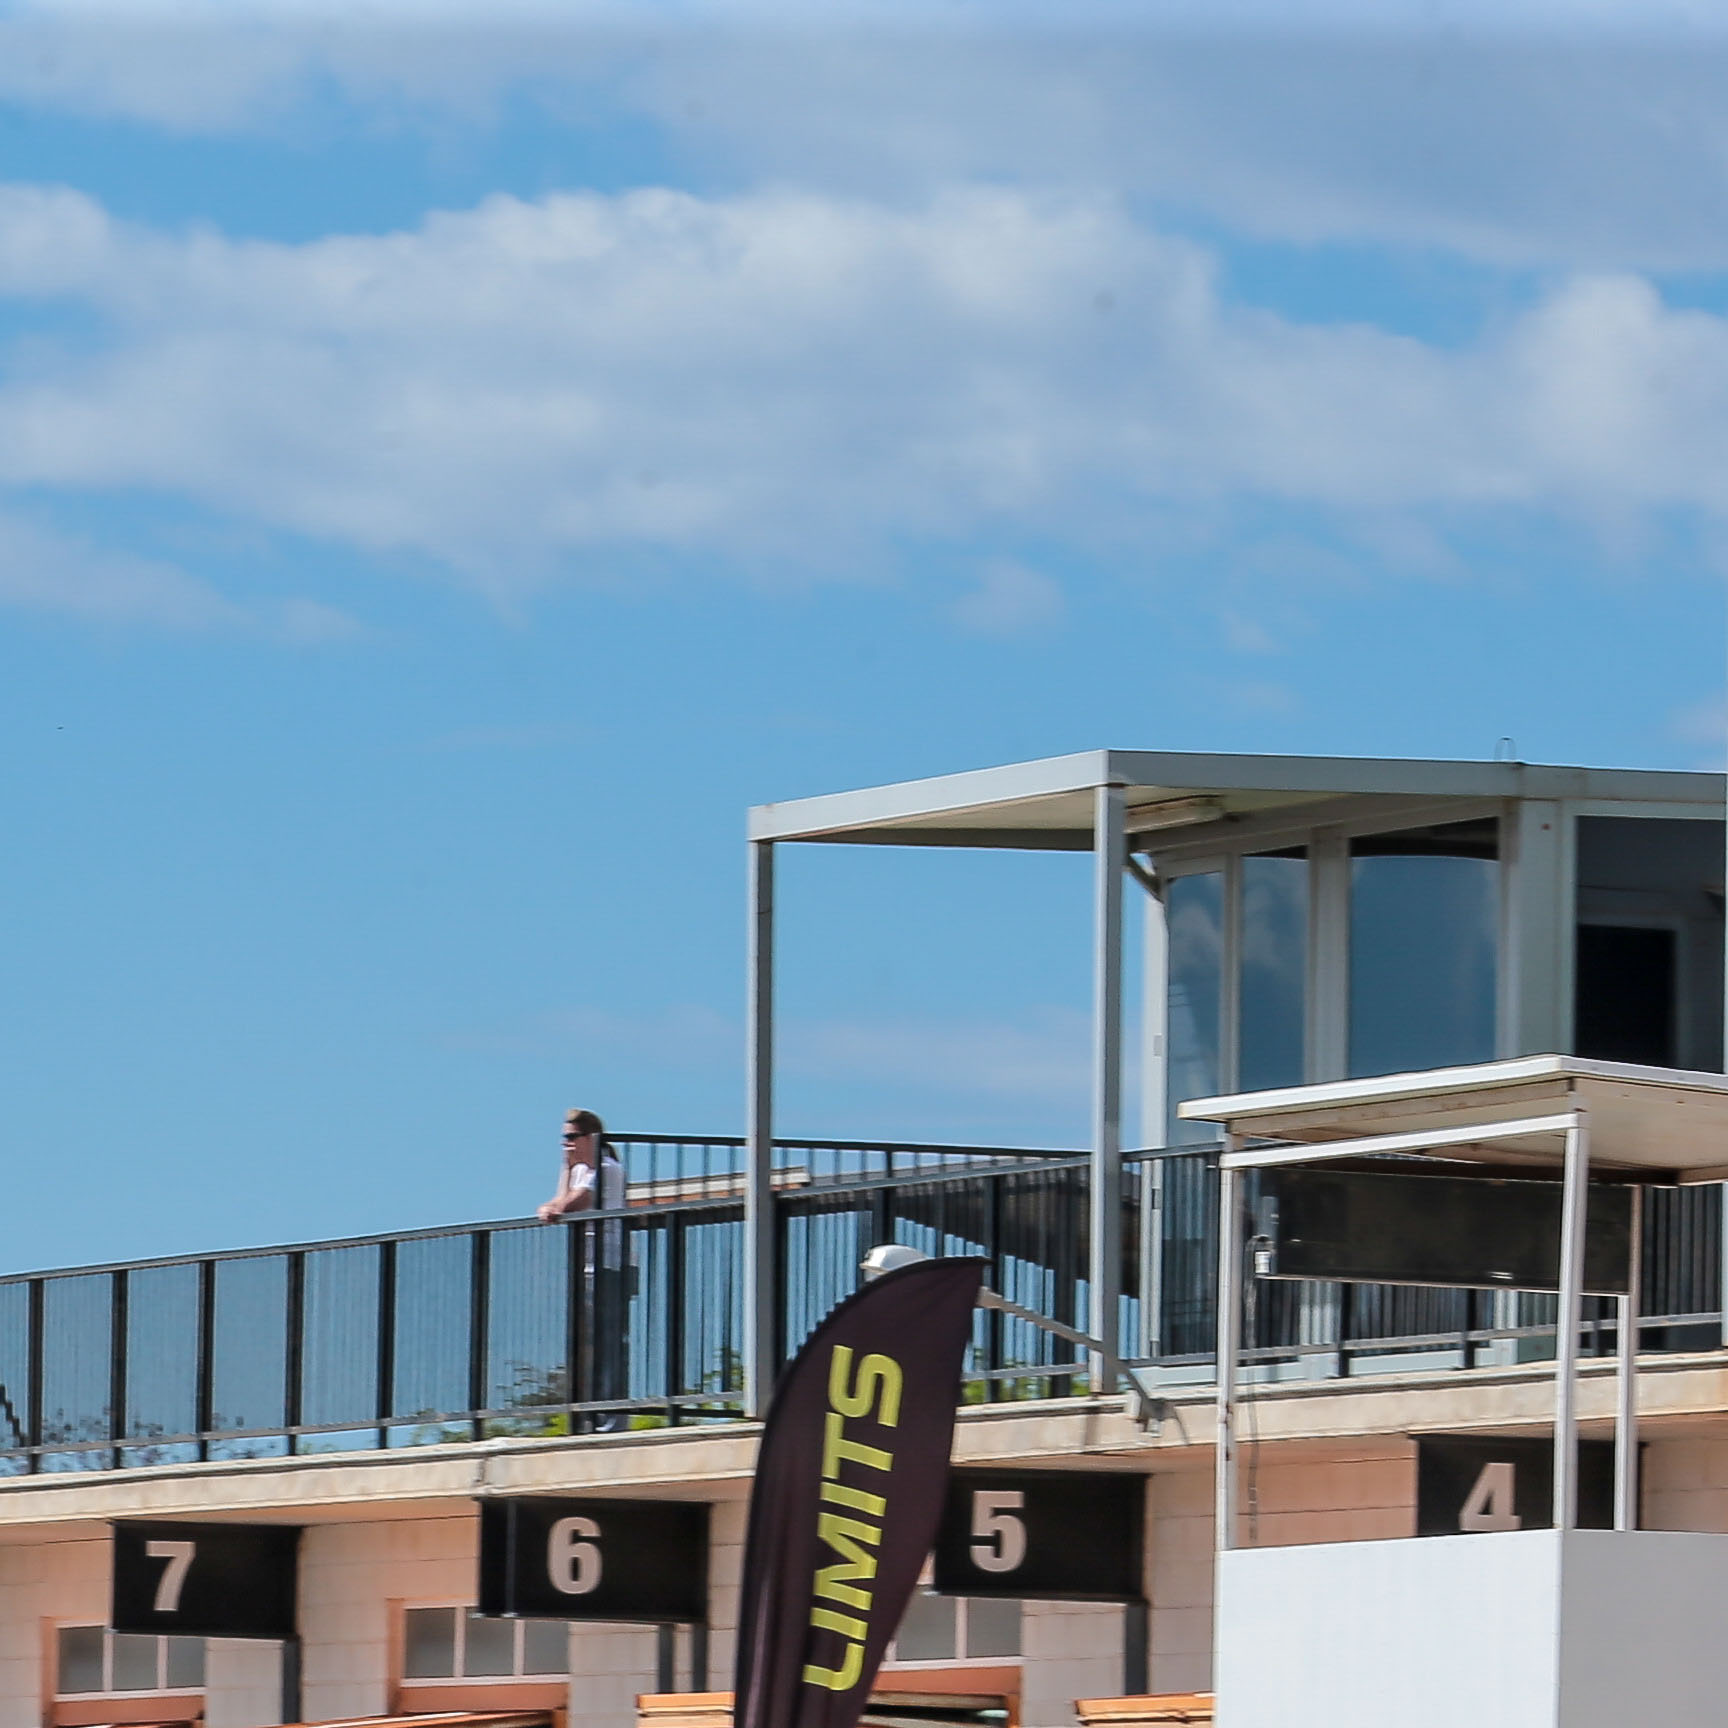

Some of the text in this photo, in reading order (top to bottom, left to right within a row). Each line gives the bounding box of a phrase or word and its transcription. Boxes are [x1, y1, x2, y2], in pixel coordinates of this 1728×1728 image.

[802, 1344, 904, 1691] LIMITS
[970, 1490, 1026, 1573] 5
[1459, 1462, 1522, 1531] 4
[145, 1540, 196, 1612] 7
[548, 1516, 601, 1595] 6
